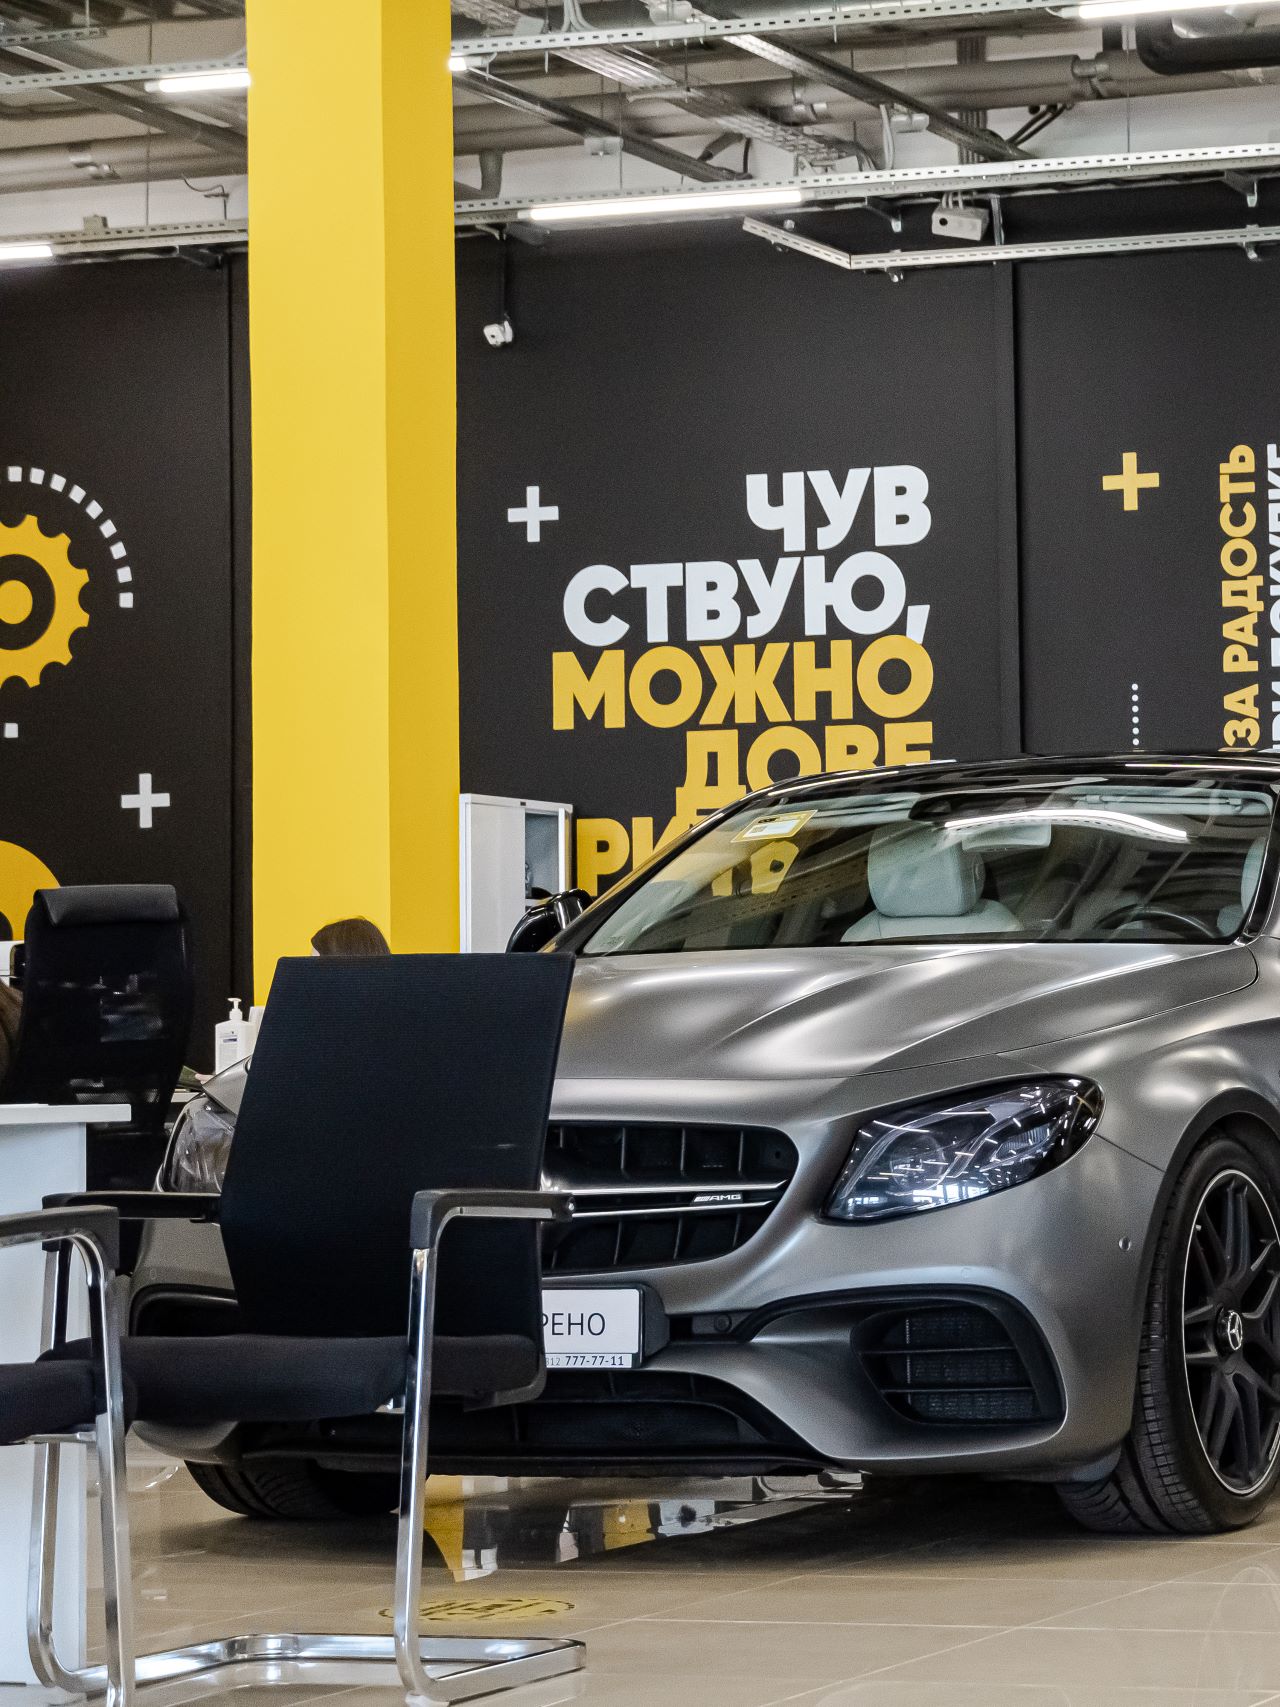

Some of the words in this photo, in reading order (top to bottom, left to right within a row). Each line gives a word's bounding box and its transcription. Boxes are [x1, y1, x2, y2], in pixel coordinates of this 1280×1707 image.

[745, 465, 932, 551] ЧУВ
[563, 551, 931, 647] СТВУЮ,
[1219, 444, 1264, 673] РАДОСТЬ
[552, 635, 934, 731] МОЖНО
[1223, 683, 1261, 747] ЗА
[565, 1355, 624, 1366] 777-77-11
